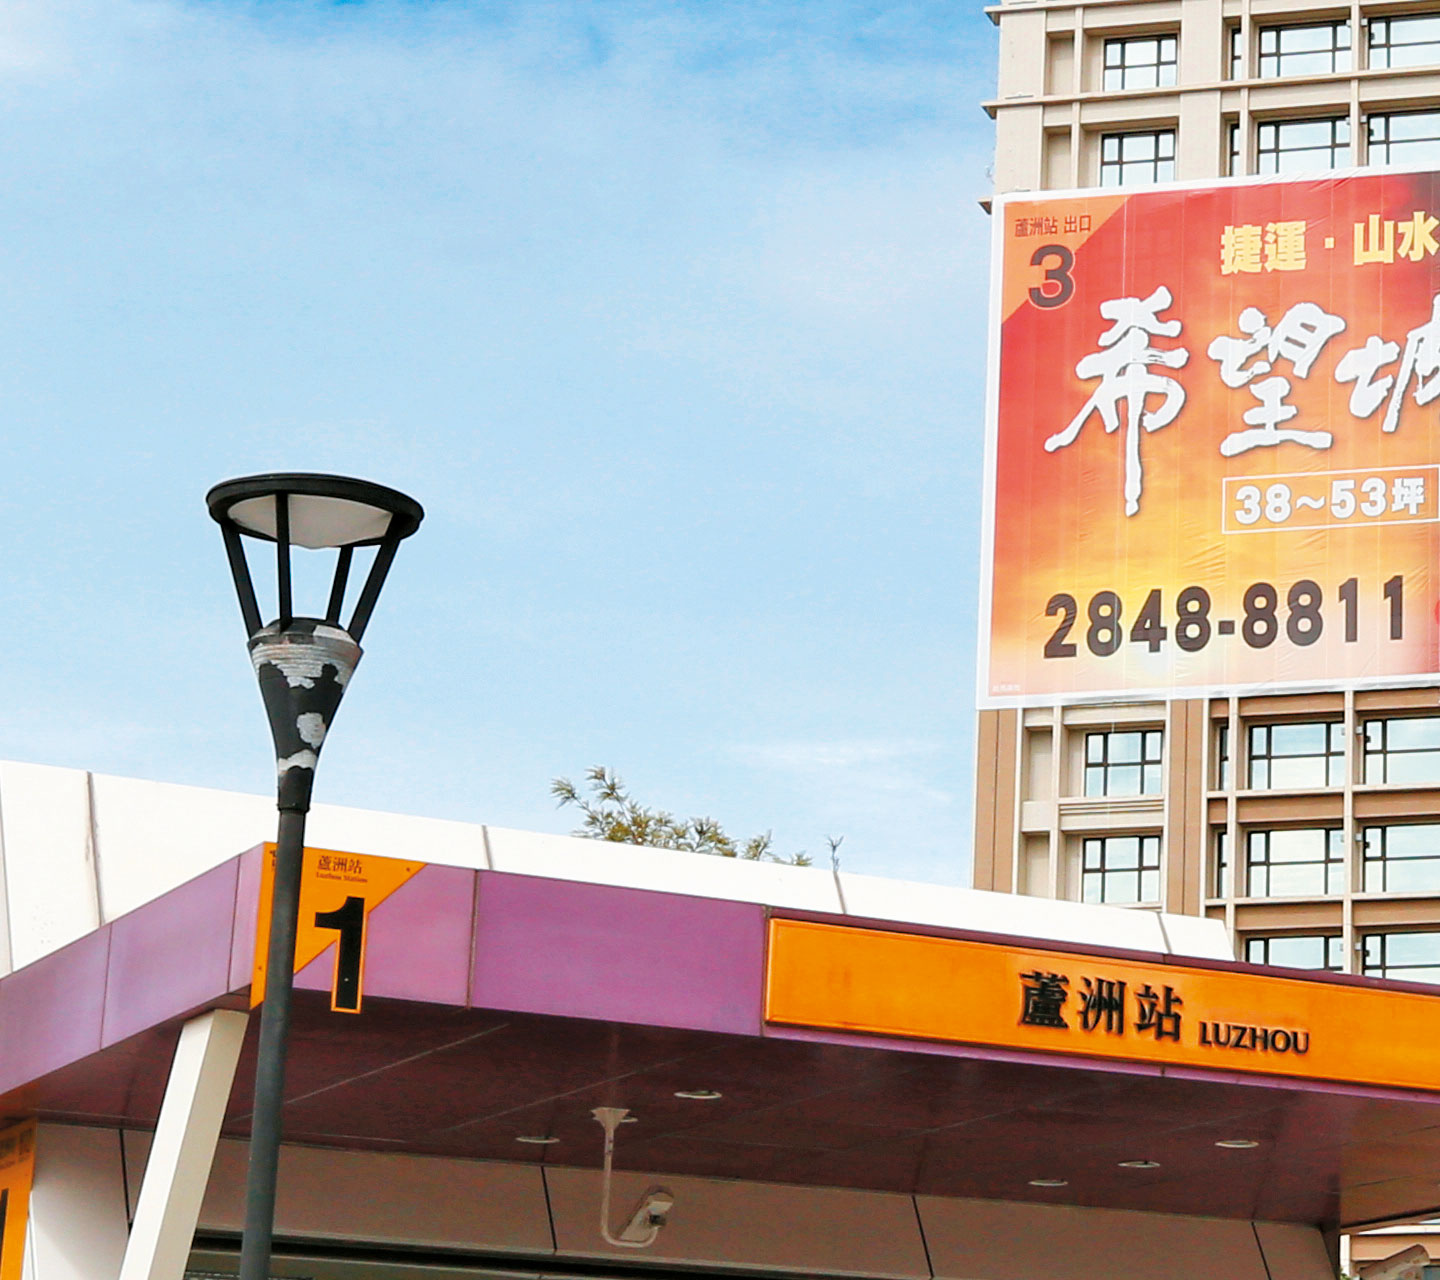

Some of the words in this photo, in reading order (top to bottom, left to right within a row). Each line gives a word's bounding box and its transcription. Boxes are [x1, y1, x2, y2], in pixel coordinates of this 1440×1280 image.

[1064, 214, 1092, 234] 出口
[1028, 243, 1076, 310] 3
[1043, 574, 1405, 659] 2848-8811
[314, 895, 366, 1011] 1
[1018, 970, 1185, 1042] 蘆洲站
[1199, 1020, 1310, 1054] LUZHOU
